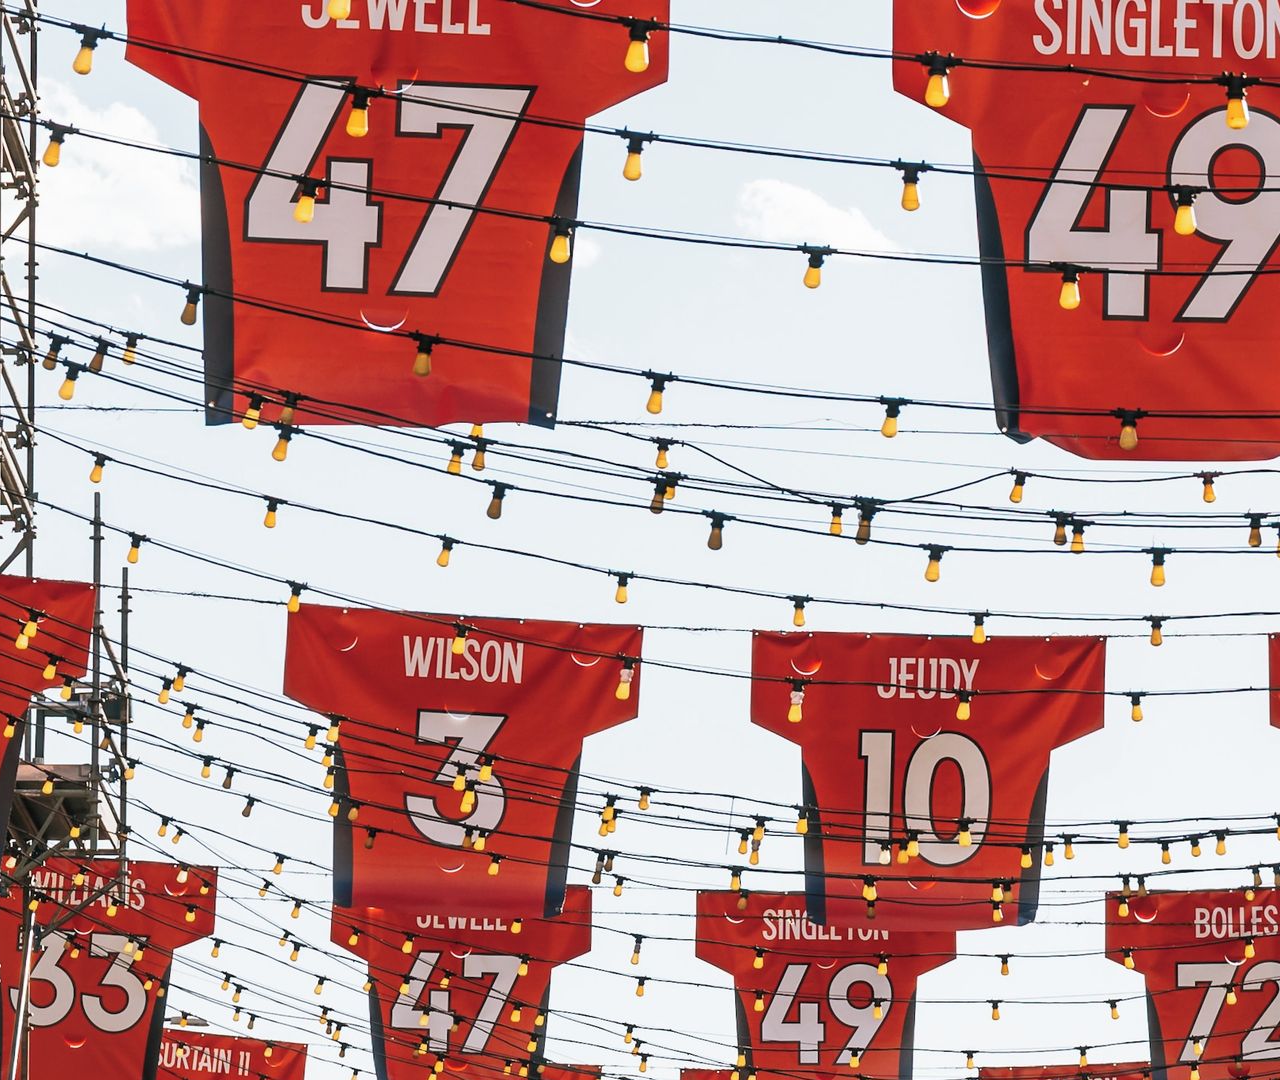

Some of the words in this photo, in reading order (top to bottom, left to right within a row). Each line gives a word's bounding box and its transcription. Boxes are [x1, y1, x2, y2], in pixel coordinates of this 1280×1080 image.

[301, 0, 491, 36] JWELL
[242, 75, 538, 298] 47
[403, 635, 524, 685] WILSON
[877, 657, 980, 700] JEUDY
[403, 708, 508, 848] 3
[857, 728, 992, 867] 10
[1194, 904, 1279, 939] BOLLES
[8, 928, 151, 1034] 33
[390, 950, 523, 1055] 47
[760, 962, 894, 1066] 49
[157, 1041, 231, 1076] SURTAIN
